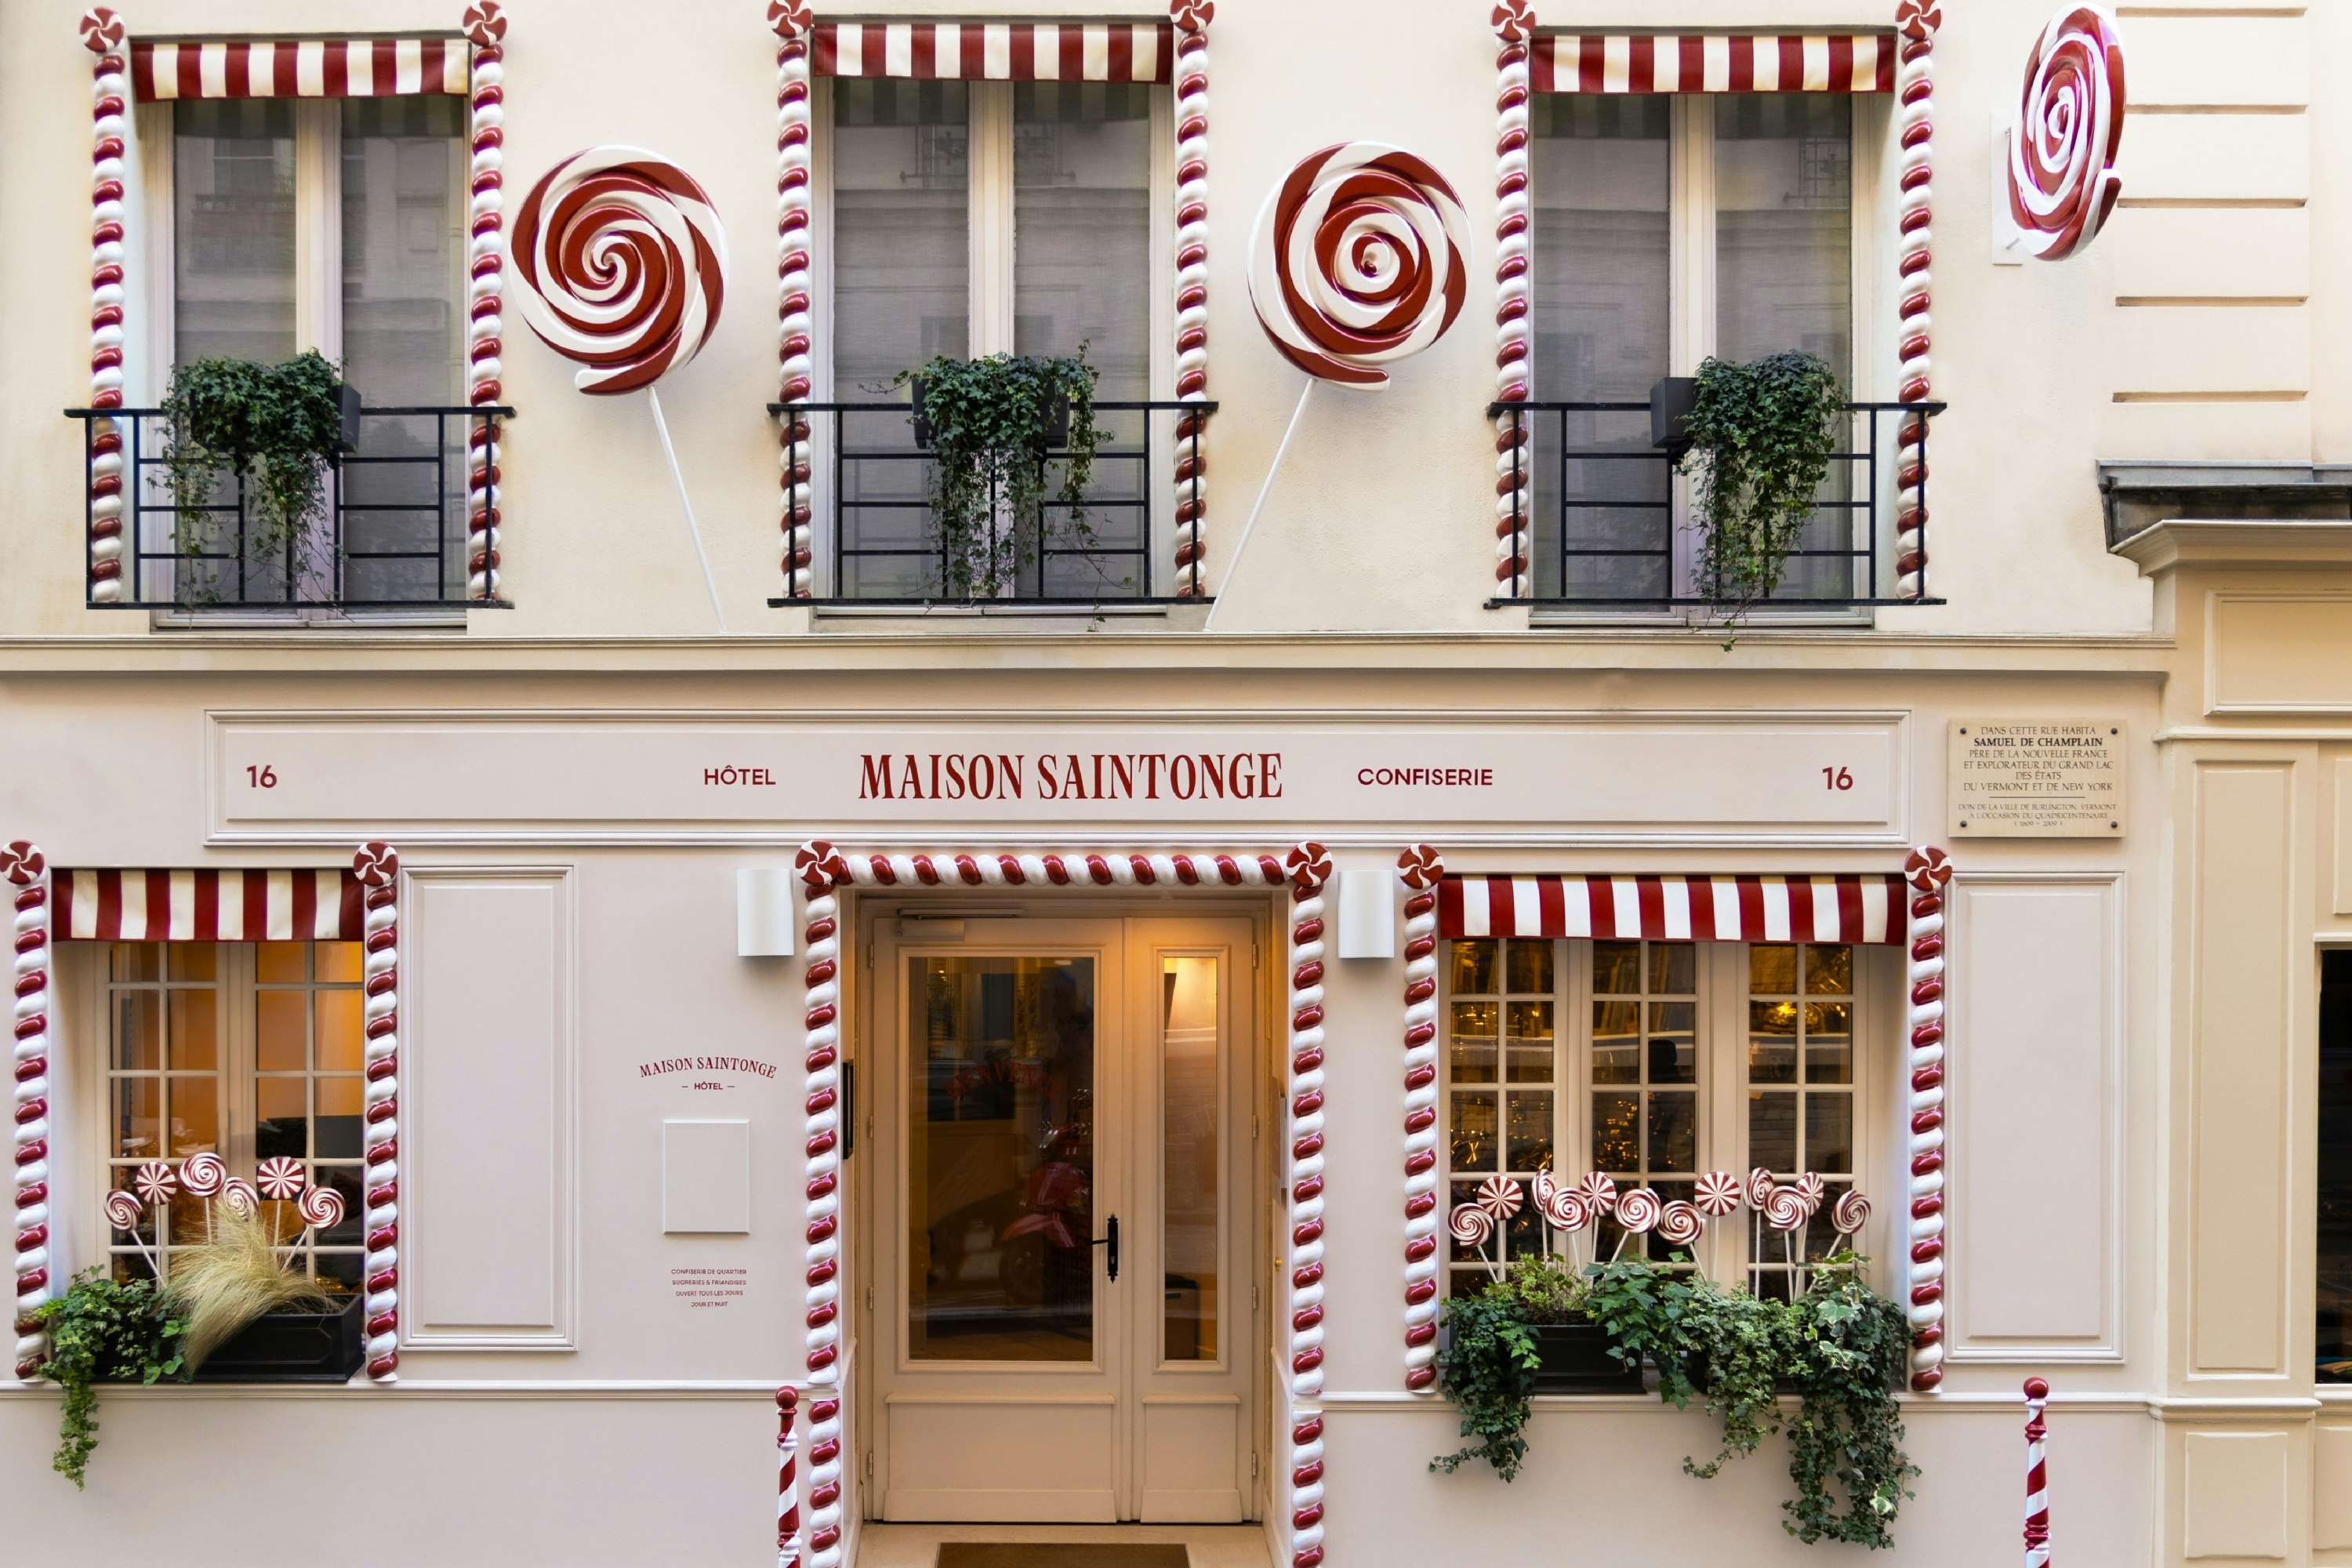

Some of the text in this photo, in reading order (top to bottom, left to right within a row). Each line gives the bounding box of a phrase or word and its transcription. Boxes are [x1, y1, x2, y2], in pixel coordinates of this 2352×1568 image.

[1981, 726, 2096, 735] DANS CETTE RUE HABITA
[1973, 738, 2103, 747] SAMUEL DE CHAMPLAIN
[1969, 748, 2108, 758] PÈRE DE LA NOUVELLE FRANCE
[1963, 760, 2114, 769] ET EXPLORATEUR DU GRAND LAC
[246, 764, 278, 789] 16
[704, 764, 776, 786] HÔTEL
[858, 753, 1283, 800] MAISON SAINTONGE
[1357, 768, 1493, 786] CONFISERIE
[1822, 766, 1853, 791] 16
[2016, 770, 2062, 780] DES ÉTATS
[1963, 782, 2113, 791] DU VERMONT ET DE NEW YORK
[640, 1056, 777, 1079] MAISON SAINTONGE
[694, 1081, 724, 1091] HÔTEL
